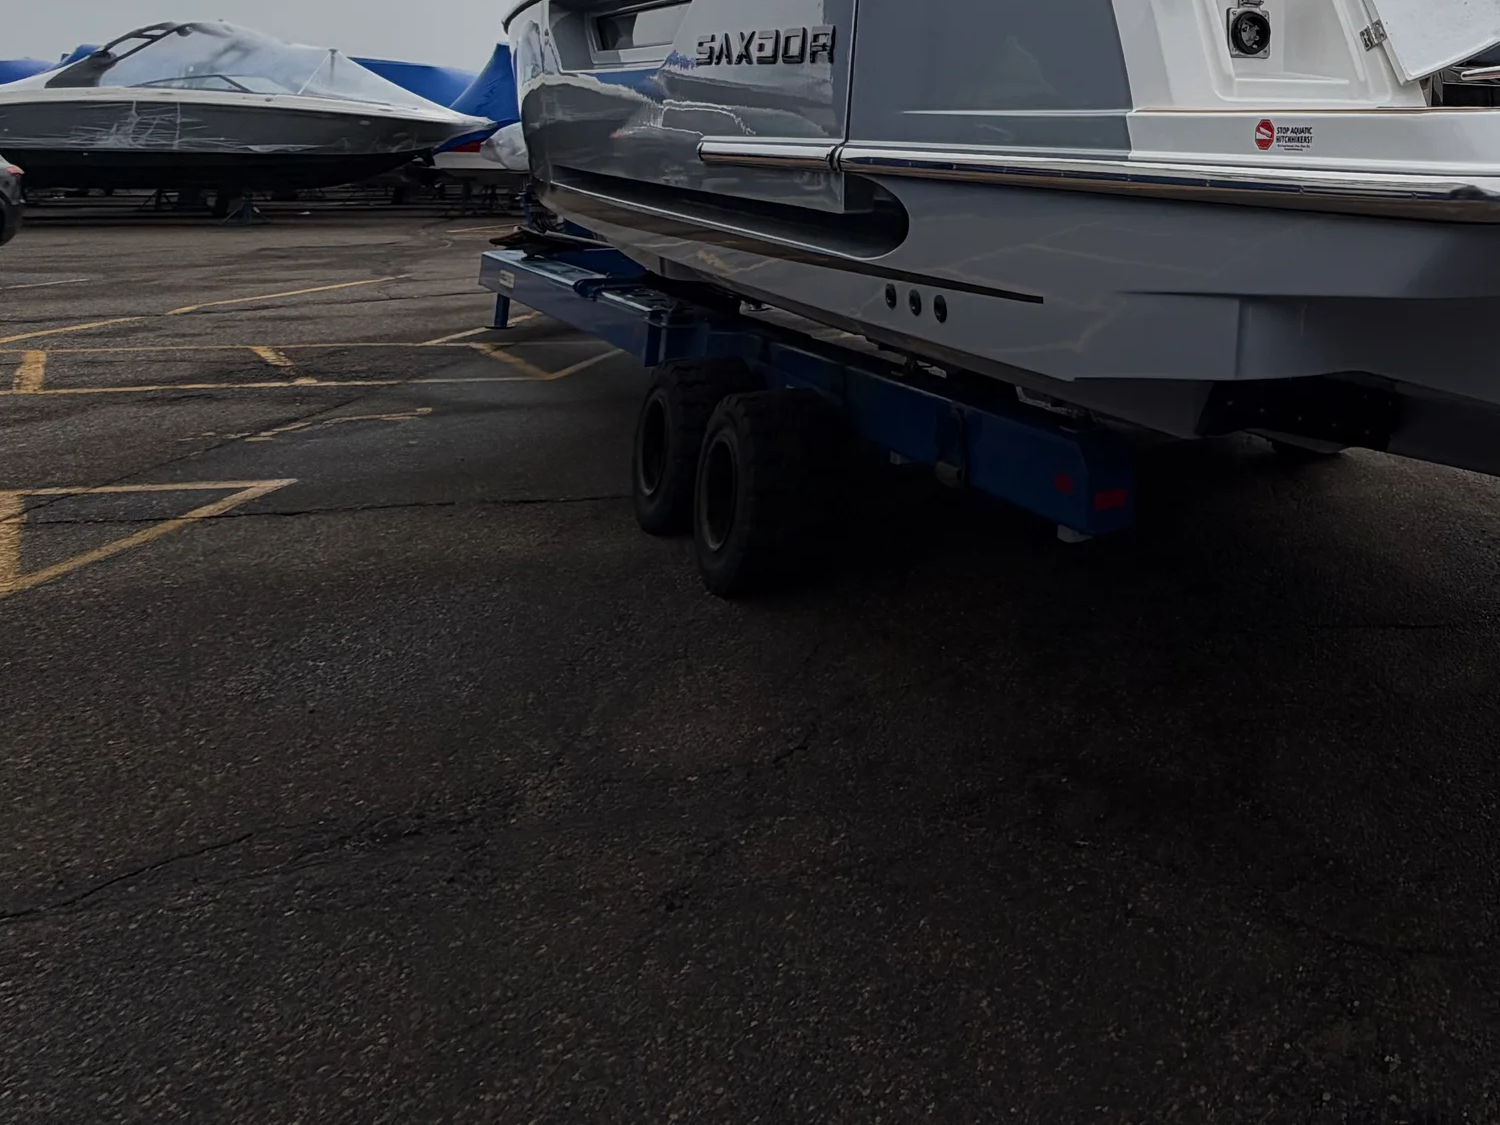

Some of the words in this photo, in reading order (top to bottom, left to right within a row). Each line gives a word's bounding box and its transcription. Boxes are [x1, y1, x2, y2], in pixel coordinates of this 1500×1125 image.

[695, 25, 836, 66] SAXDOR
[1276, 126, 1290, 135] STOP
[1290, 126, 1313, 136] AQUATIC
